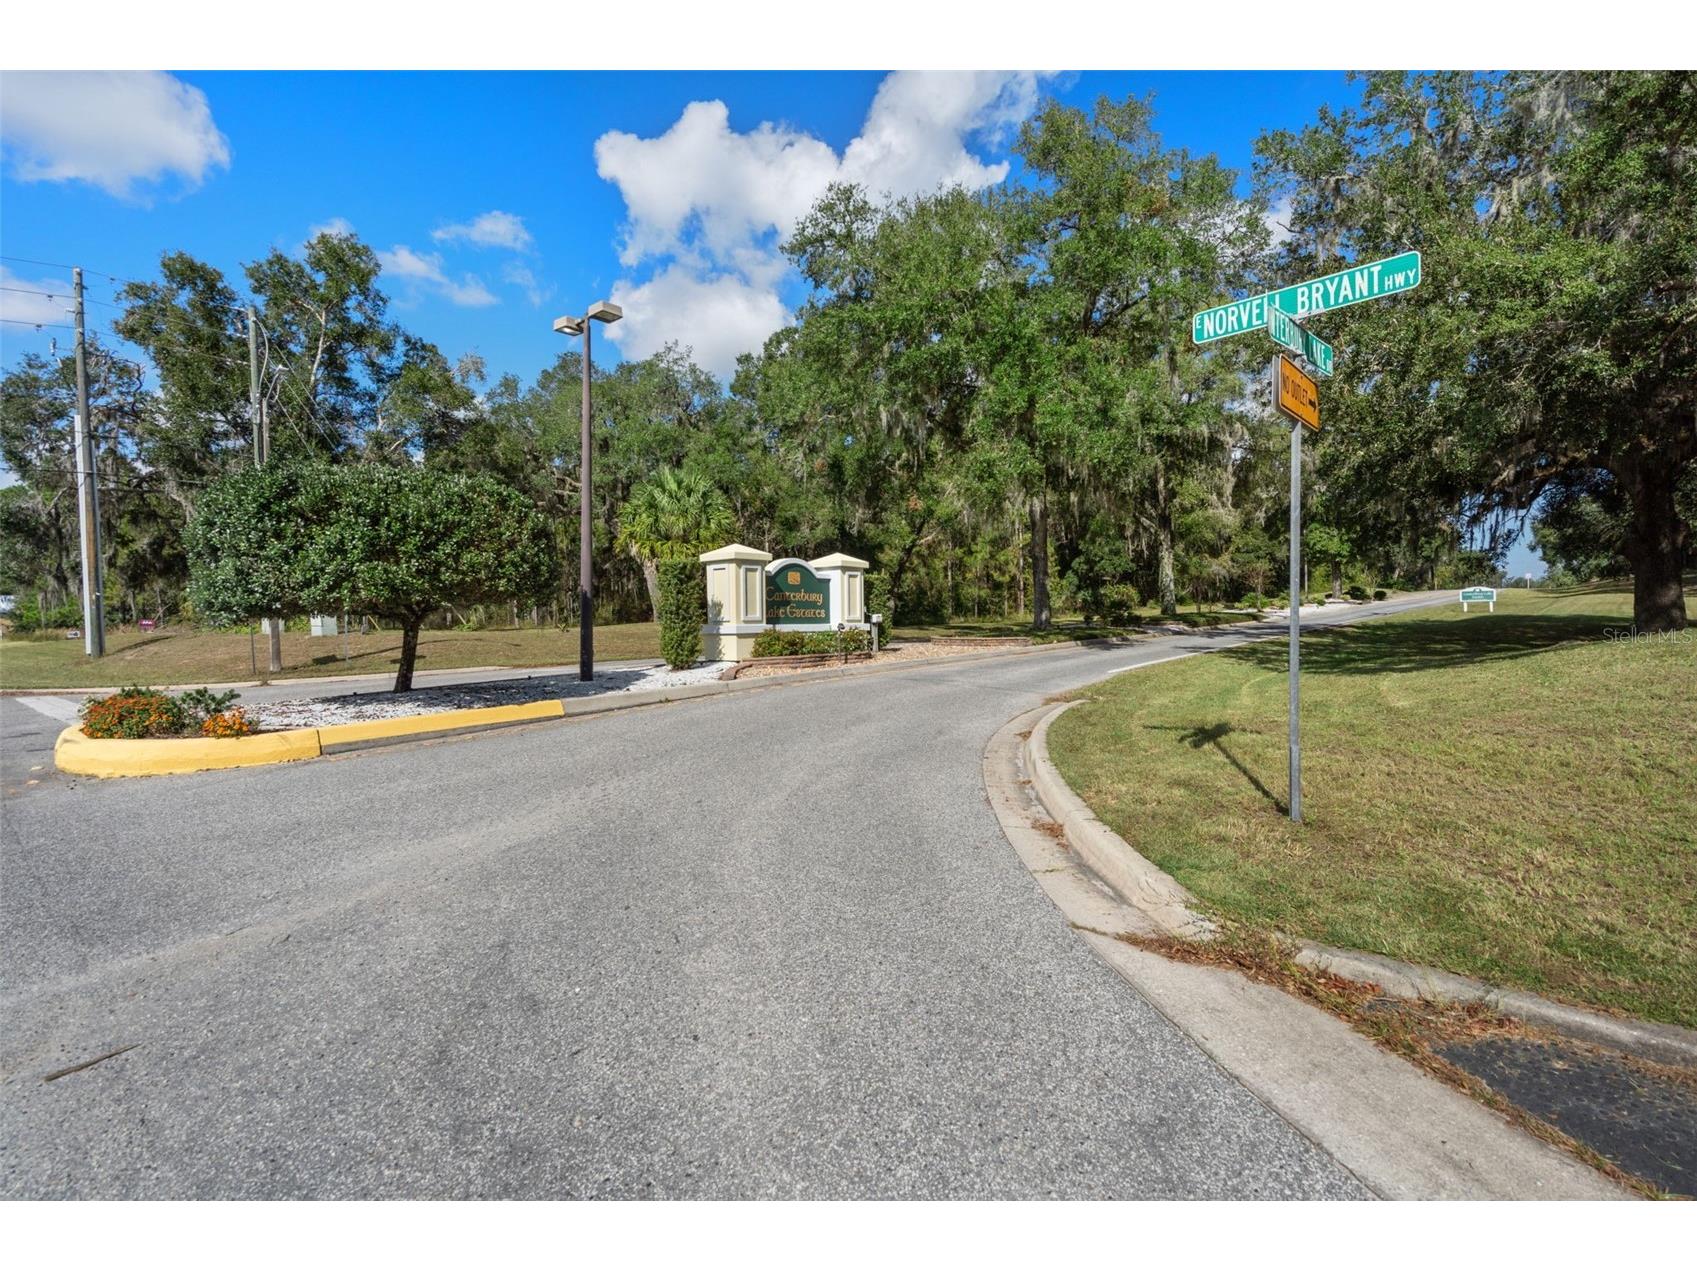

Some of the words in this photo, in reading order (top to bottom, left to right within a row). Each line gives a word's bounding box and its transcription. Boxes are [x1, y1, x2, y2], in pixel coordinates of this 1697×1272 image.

[1196, 317, 1202, 330] E
[1297, 265, 1382, 315] BRYANT
[1384, 269, 1416, 291] HWY
[766, 604, 785, 618] ake
